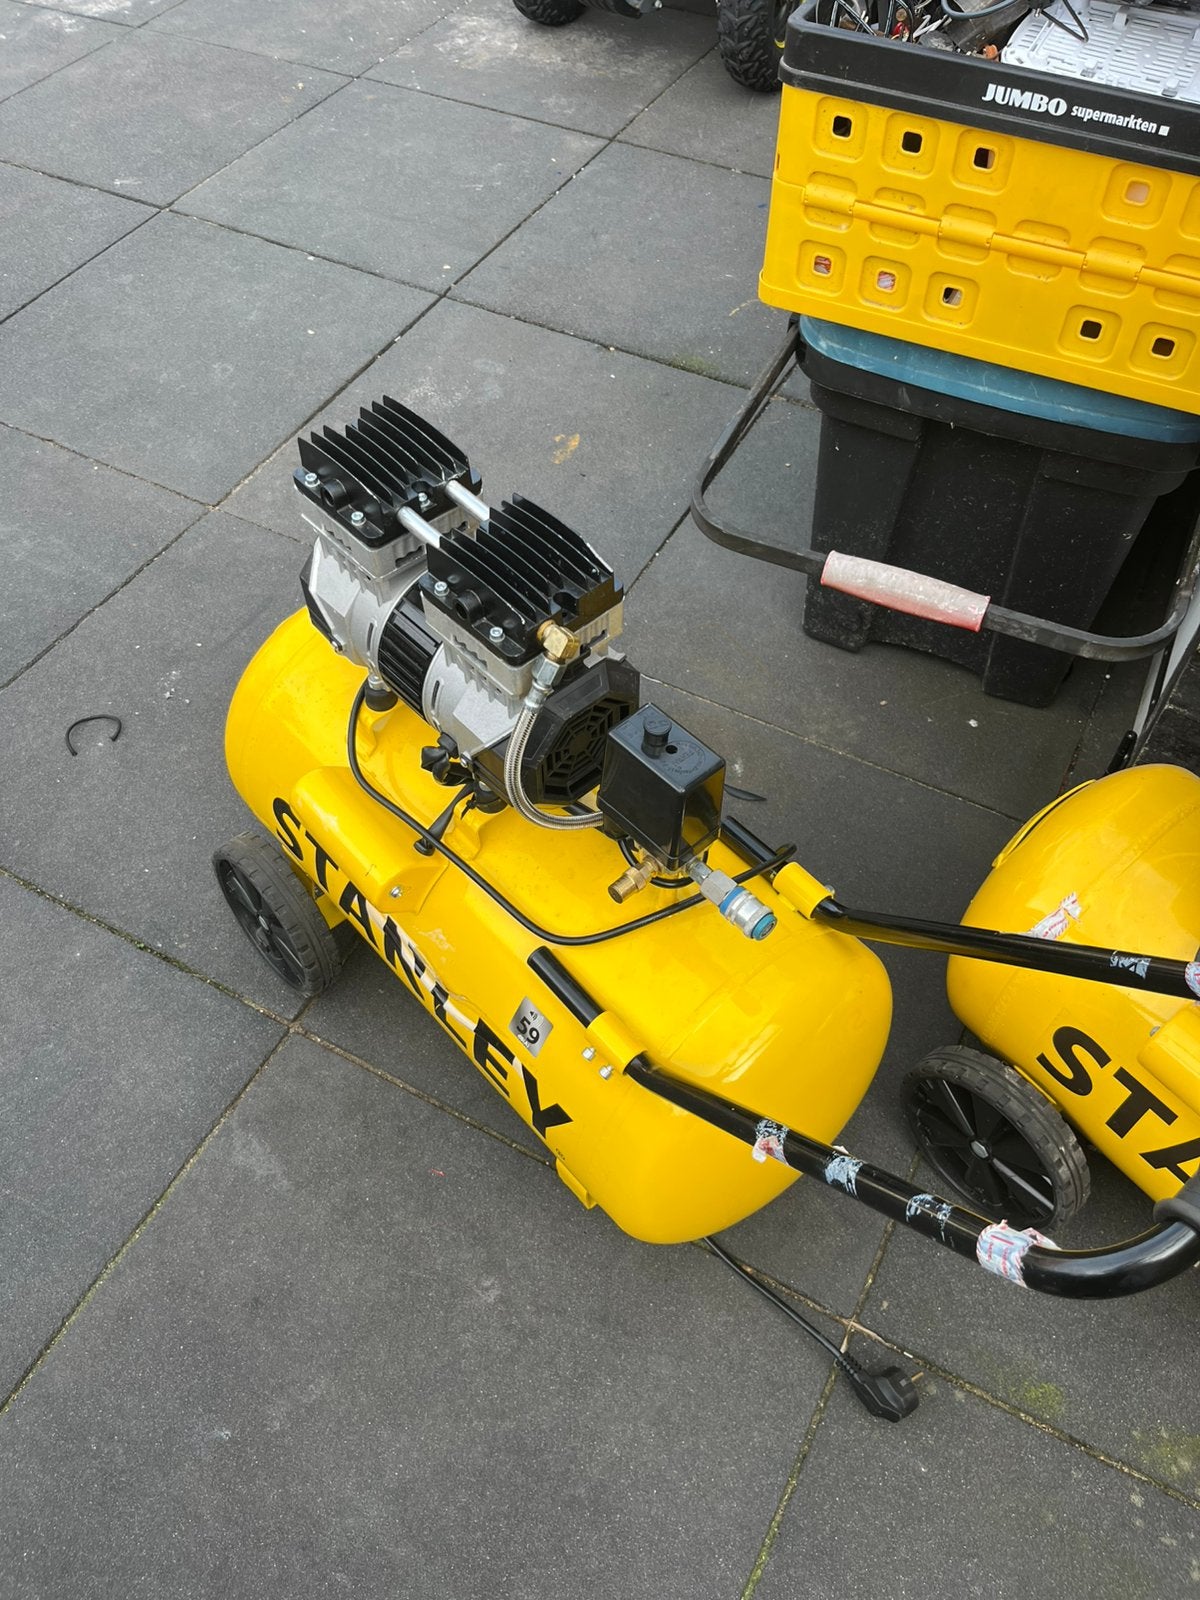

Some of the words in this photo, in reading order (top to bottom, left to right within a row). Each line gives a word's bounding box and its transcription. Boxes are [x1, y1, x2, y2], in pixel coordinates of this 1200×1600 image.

[981, 83, 1067, 117] JUMBO
[1071, 105, 1157, 133] supermarkten
[273, 797, 573, 1139] STANLEY
[516, 1016, 540, 1044] 59
